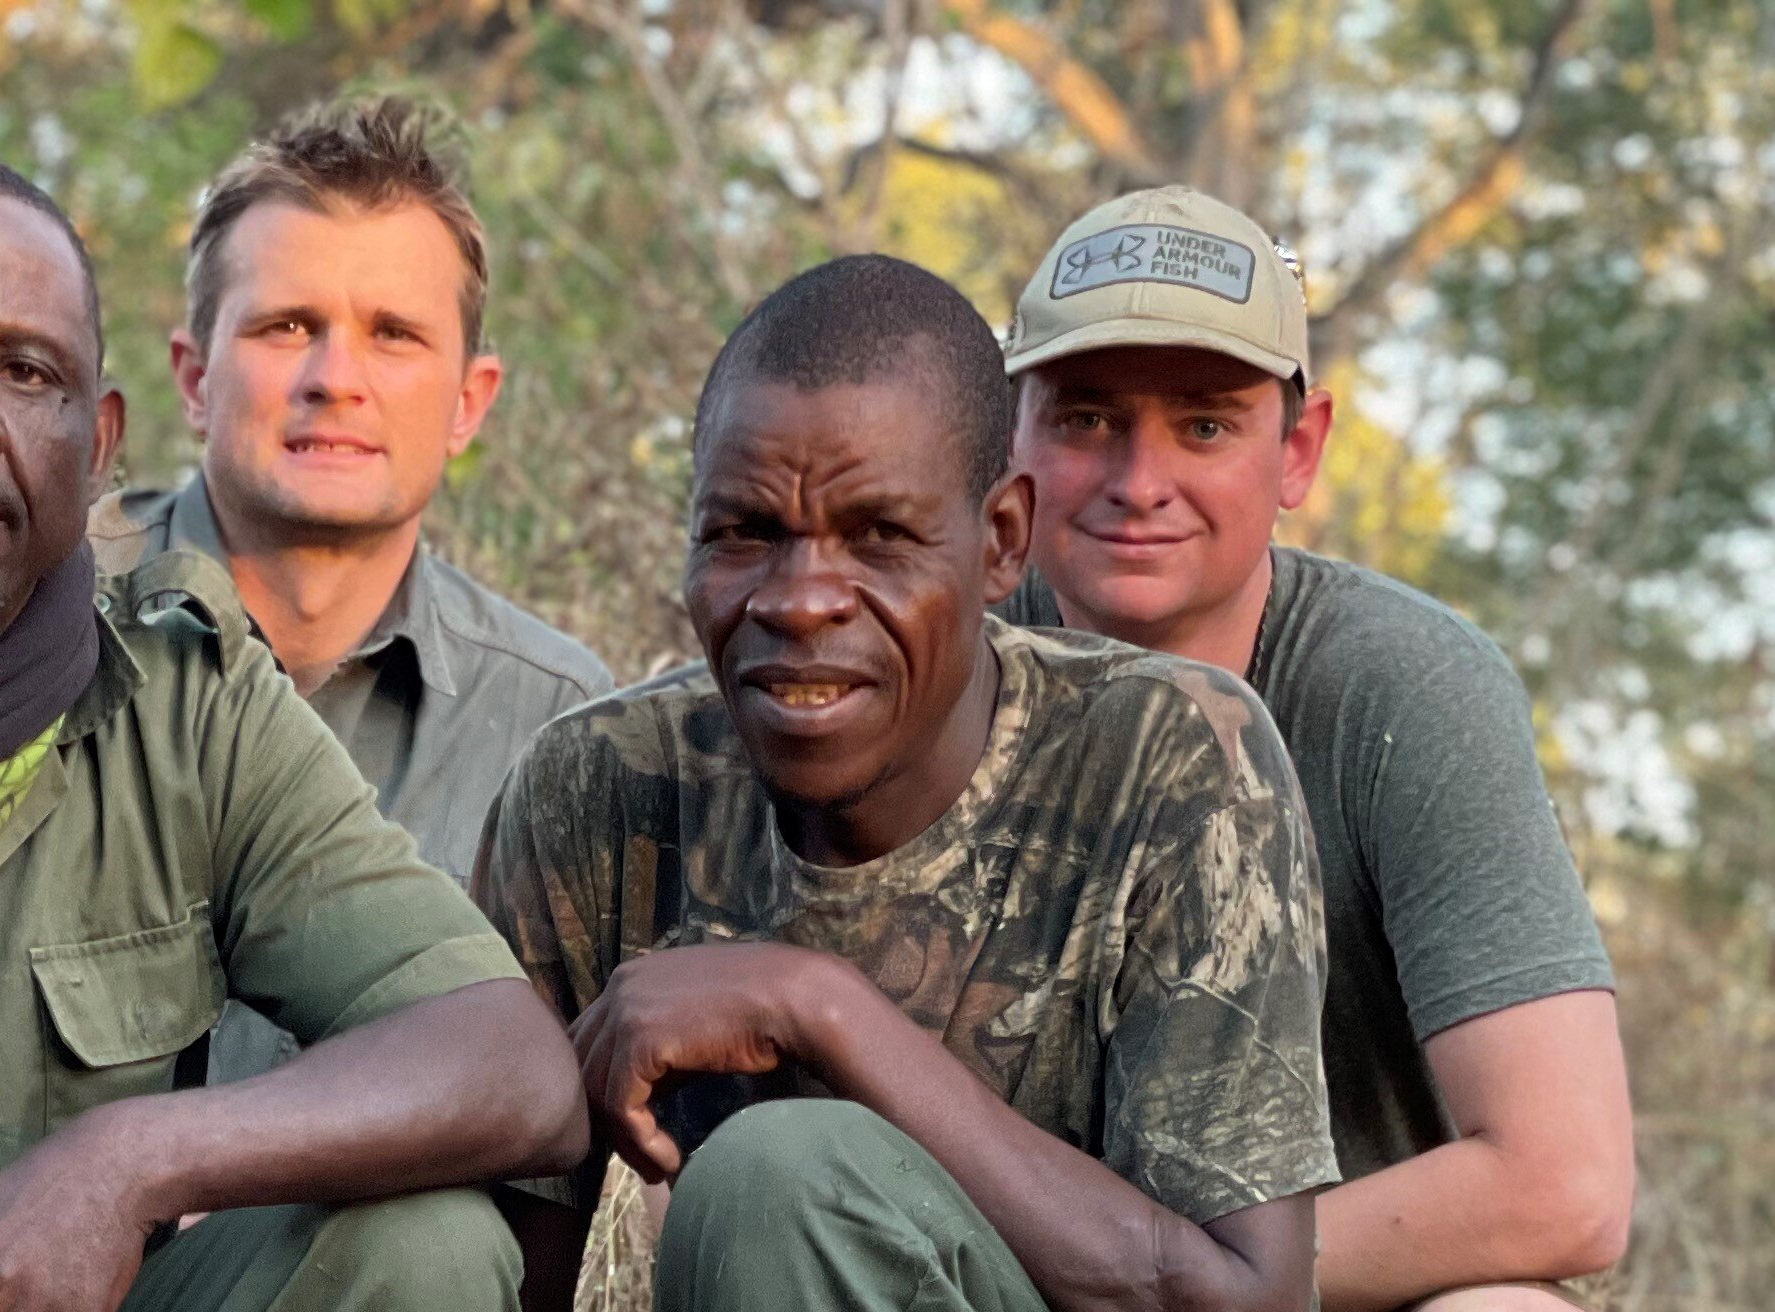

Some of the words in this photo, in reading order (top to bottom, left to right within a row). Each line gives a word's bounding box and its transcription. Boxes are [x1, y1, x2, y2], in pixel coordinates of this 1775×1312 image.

[1157, 230, 1225, 258] UNDER
[1151, 261, 1199, 280] FISH
[1152, 246, 1240, 280] ARMOUR
